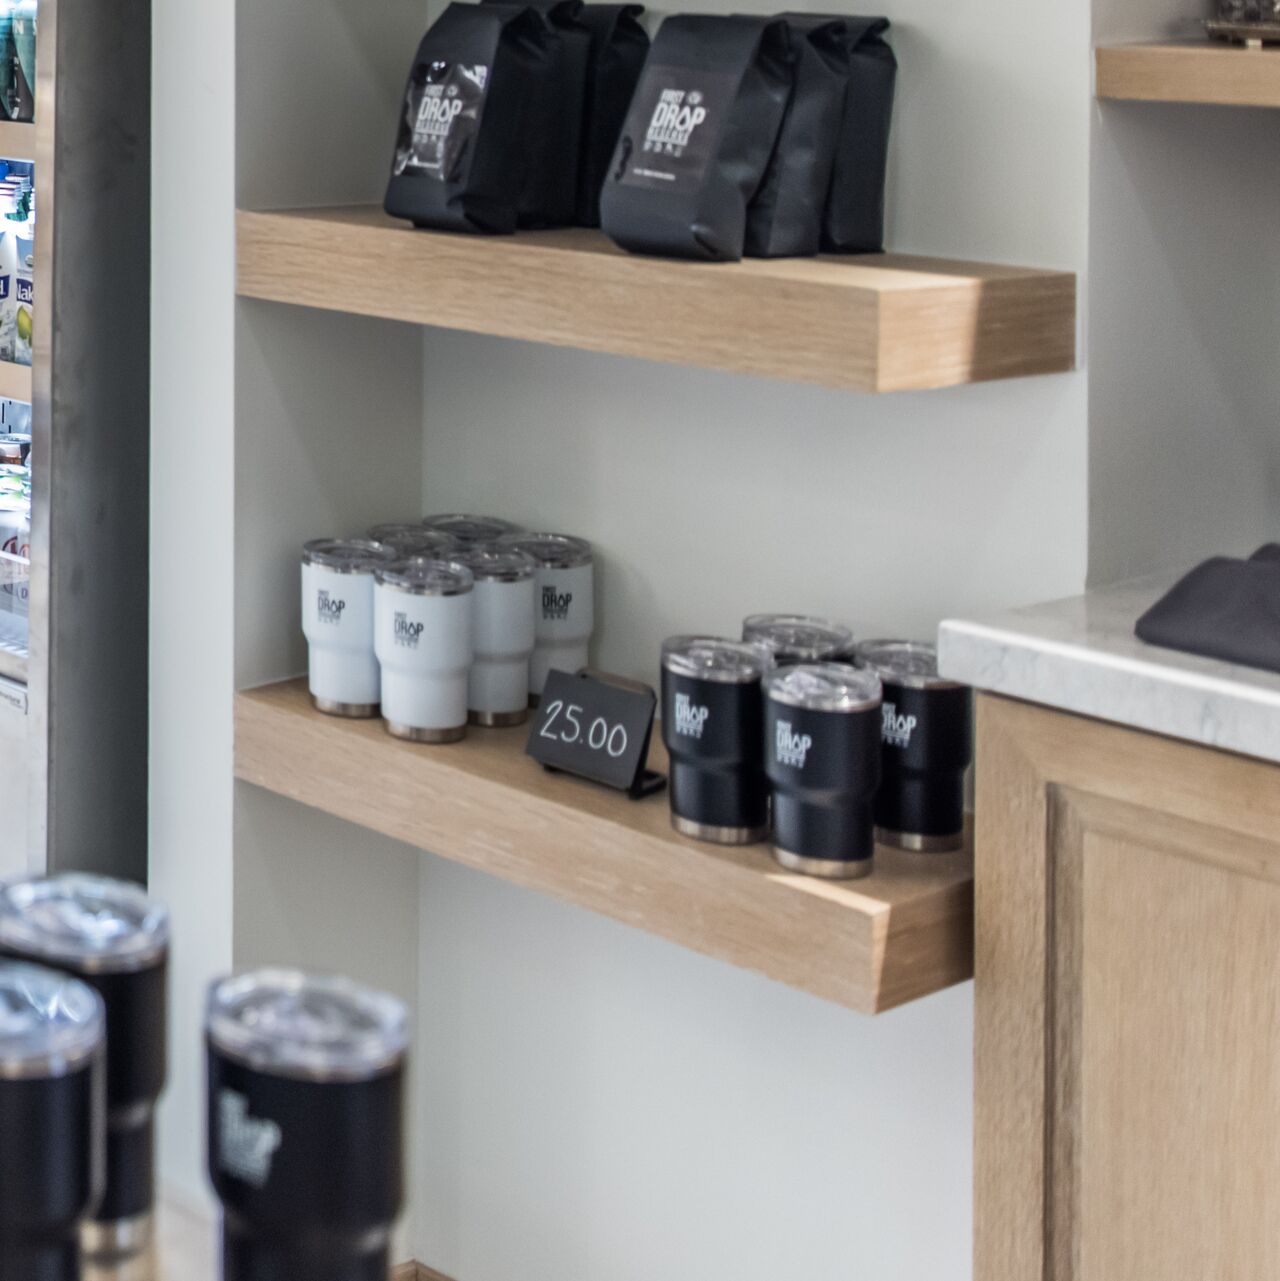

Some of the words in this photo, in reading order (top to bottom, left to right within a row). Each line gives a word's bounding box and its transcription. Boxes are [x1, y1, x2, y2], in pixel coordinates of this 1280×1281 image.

[418, 96, 463, 122] DROP
[651, 102, 706, 132] DROP
[317, 596, 345, 614] DROP
[542, 592, 572, 610] DROP
[394, 620, 424, 637] DROP
[675, 703, 709, 724] DROP
[539, 699, 628, 758] 25.00
[776, 729, 812, 752] DROP
